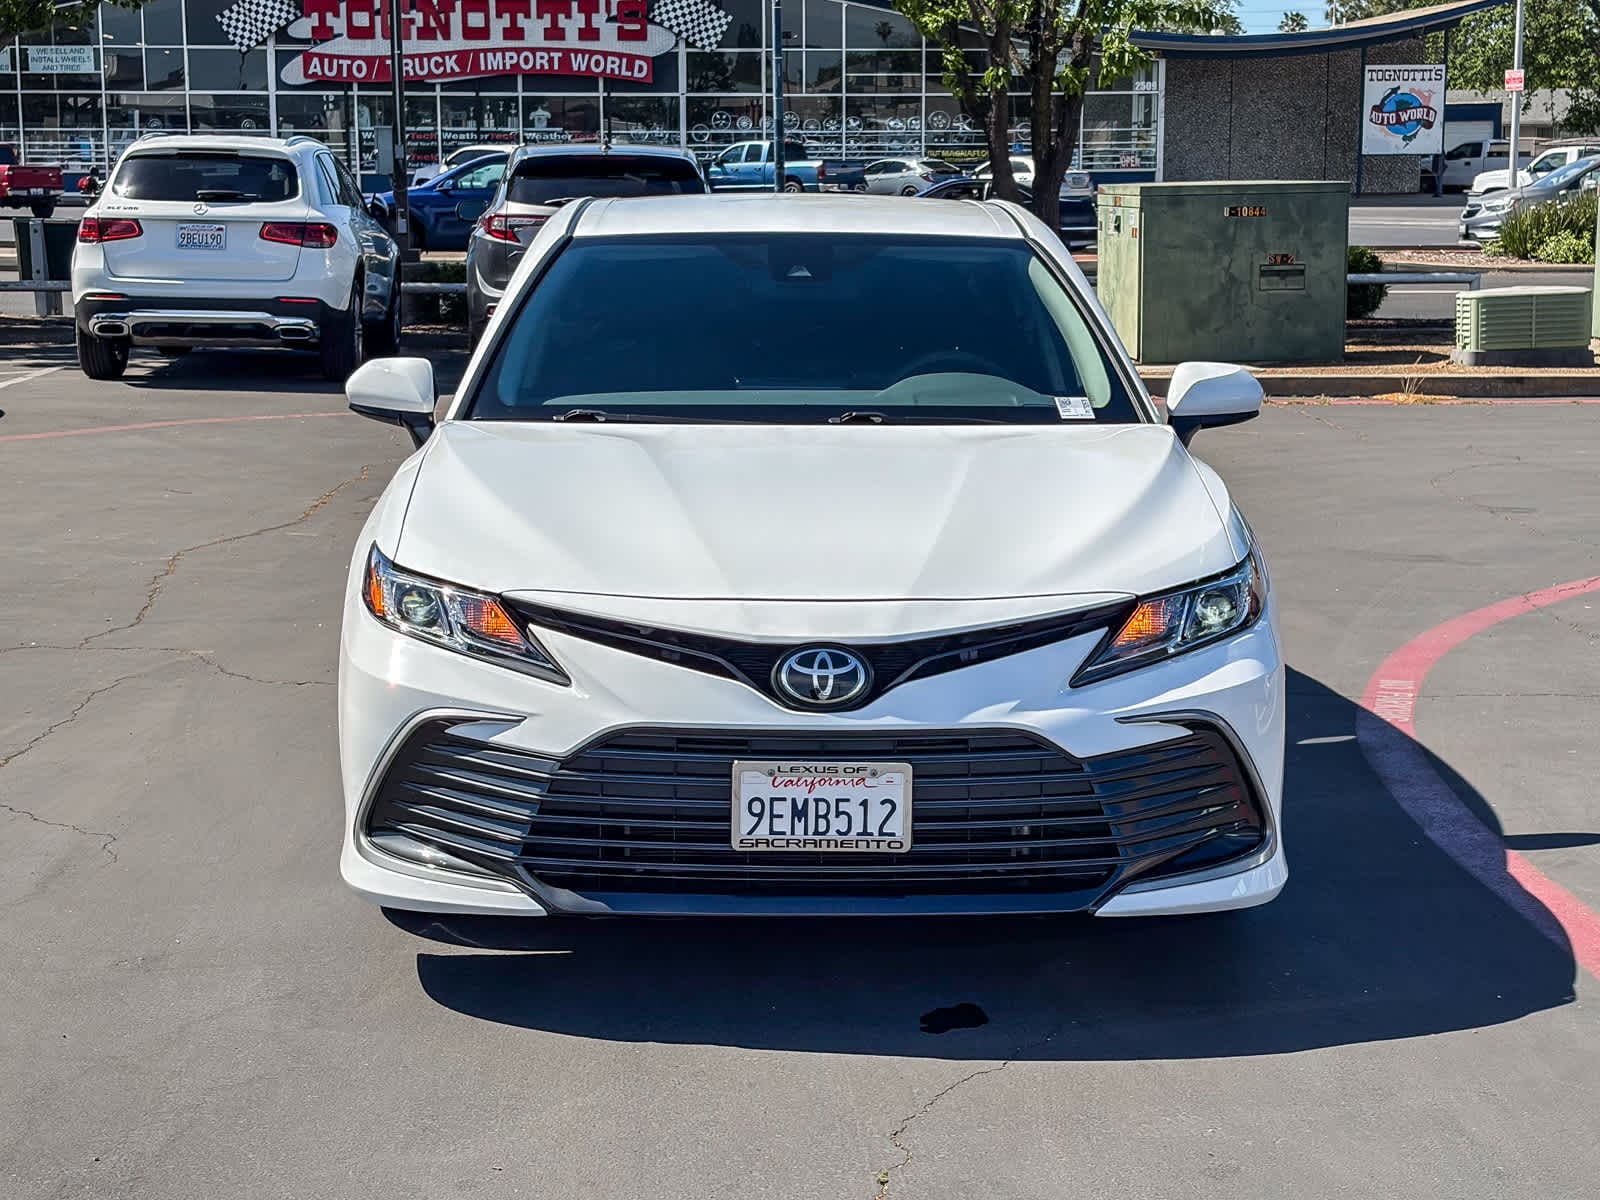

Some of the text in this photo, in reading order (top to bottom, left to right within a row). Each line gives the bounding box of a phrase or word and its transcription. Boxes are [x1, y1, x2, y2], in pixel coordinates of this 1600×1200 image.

[308, 56, 368, 78] AUTO
[479, 51, 562, 71] IMPORT
[570, 52, 648, 79] WORLD
[1367, 66, 1443, 82] TOGNOTTI'S
[1135, 81, 1157, 91] 2509
[1370, 107, 1435, 125] AUTO WORLD
[777, 765, 868, 774] LEXUS OF
[746, 796, 898, 837] 9EMB512
[738, 838, 904, 849] SACRAMENTO
